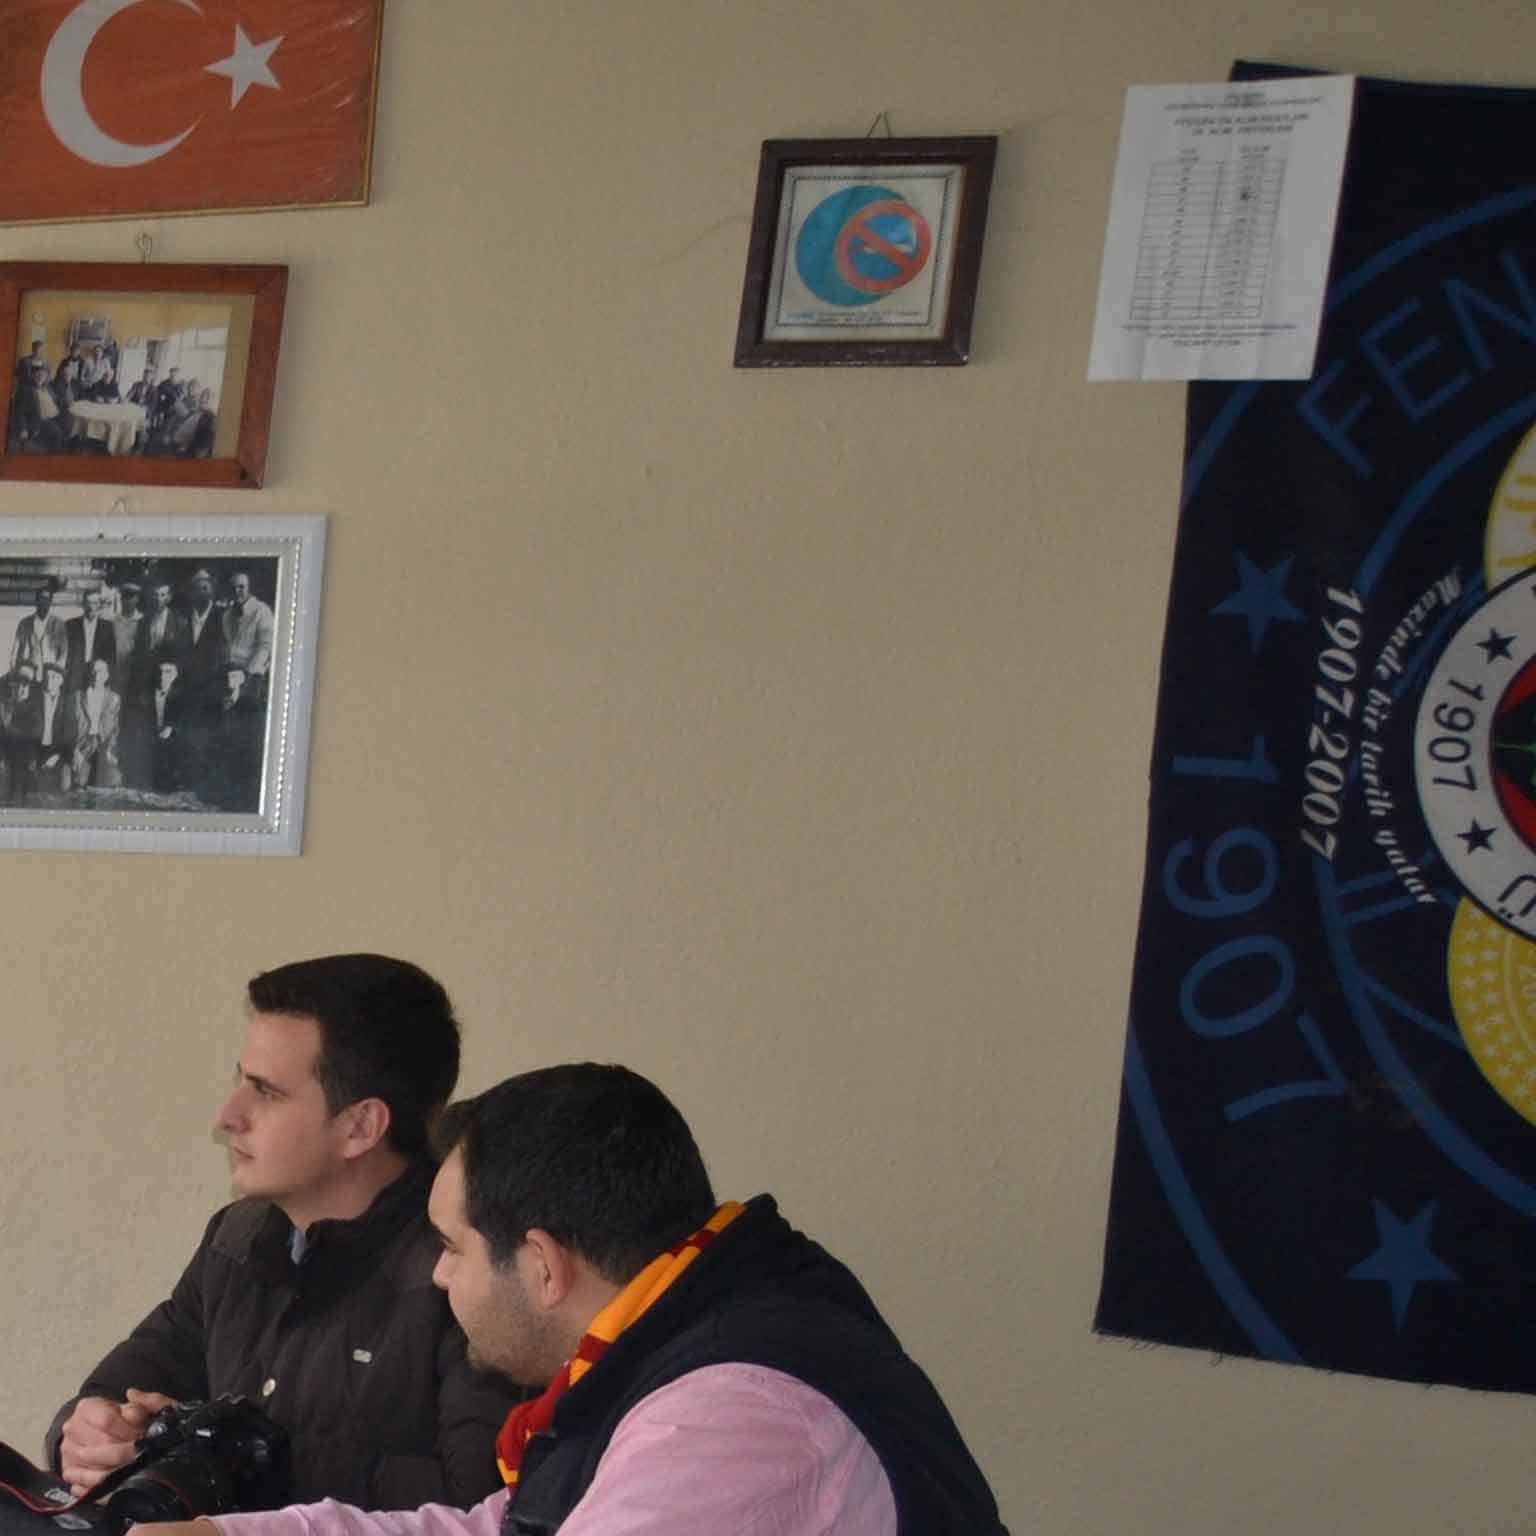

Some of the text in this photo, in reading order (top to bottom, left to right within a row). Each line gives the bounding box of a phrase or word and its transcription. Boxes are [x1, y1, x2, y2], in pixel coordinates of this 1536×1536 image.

[1300, 586, 1365, 862] 1907-2007
[1362, 687, 1392, 732] bir
[1428, 679, 1485, 791] 1907
[1361, 741, 1394, 816] tarih
[1162, 735, 1347, 1122] 1907
